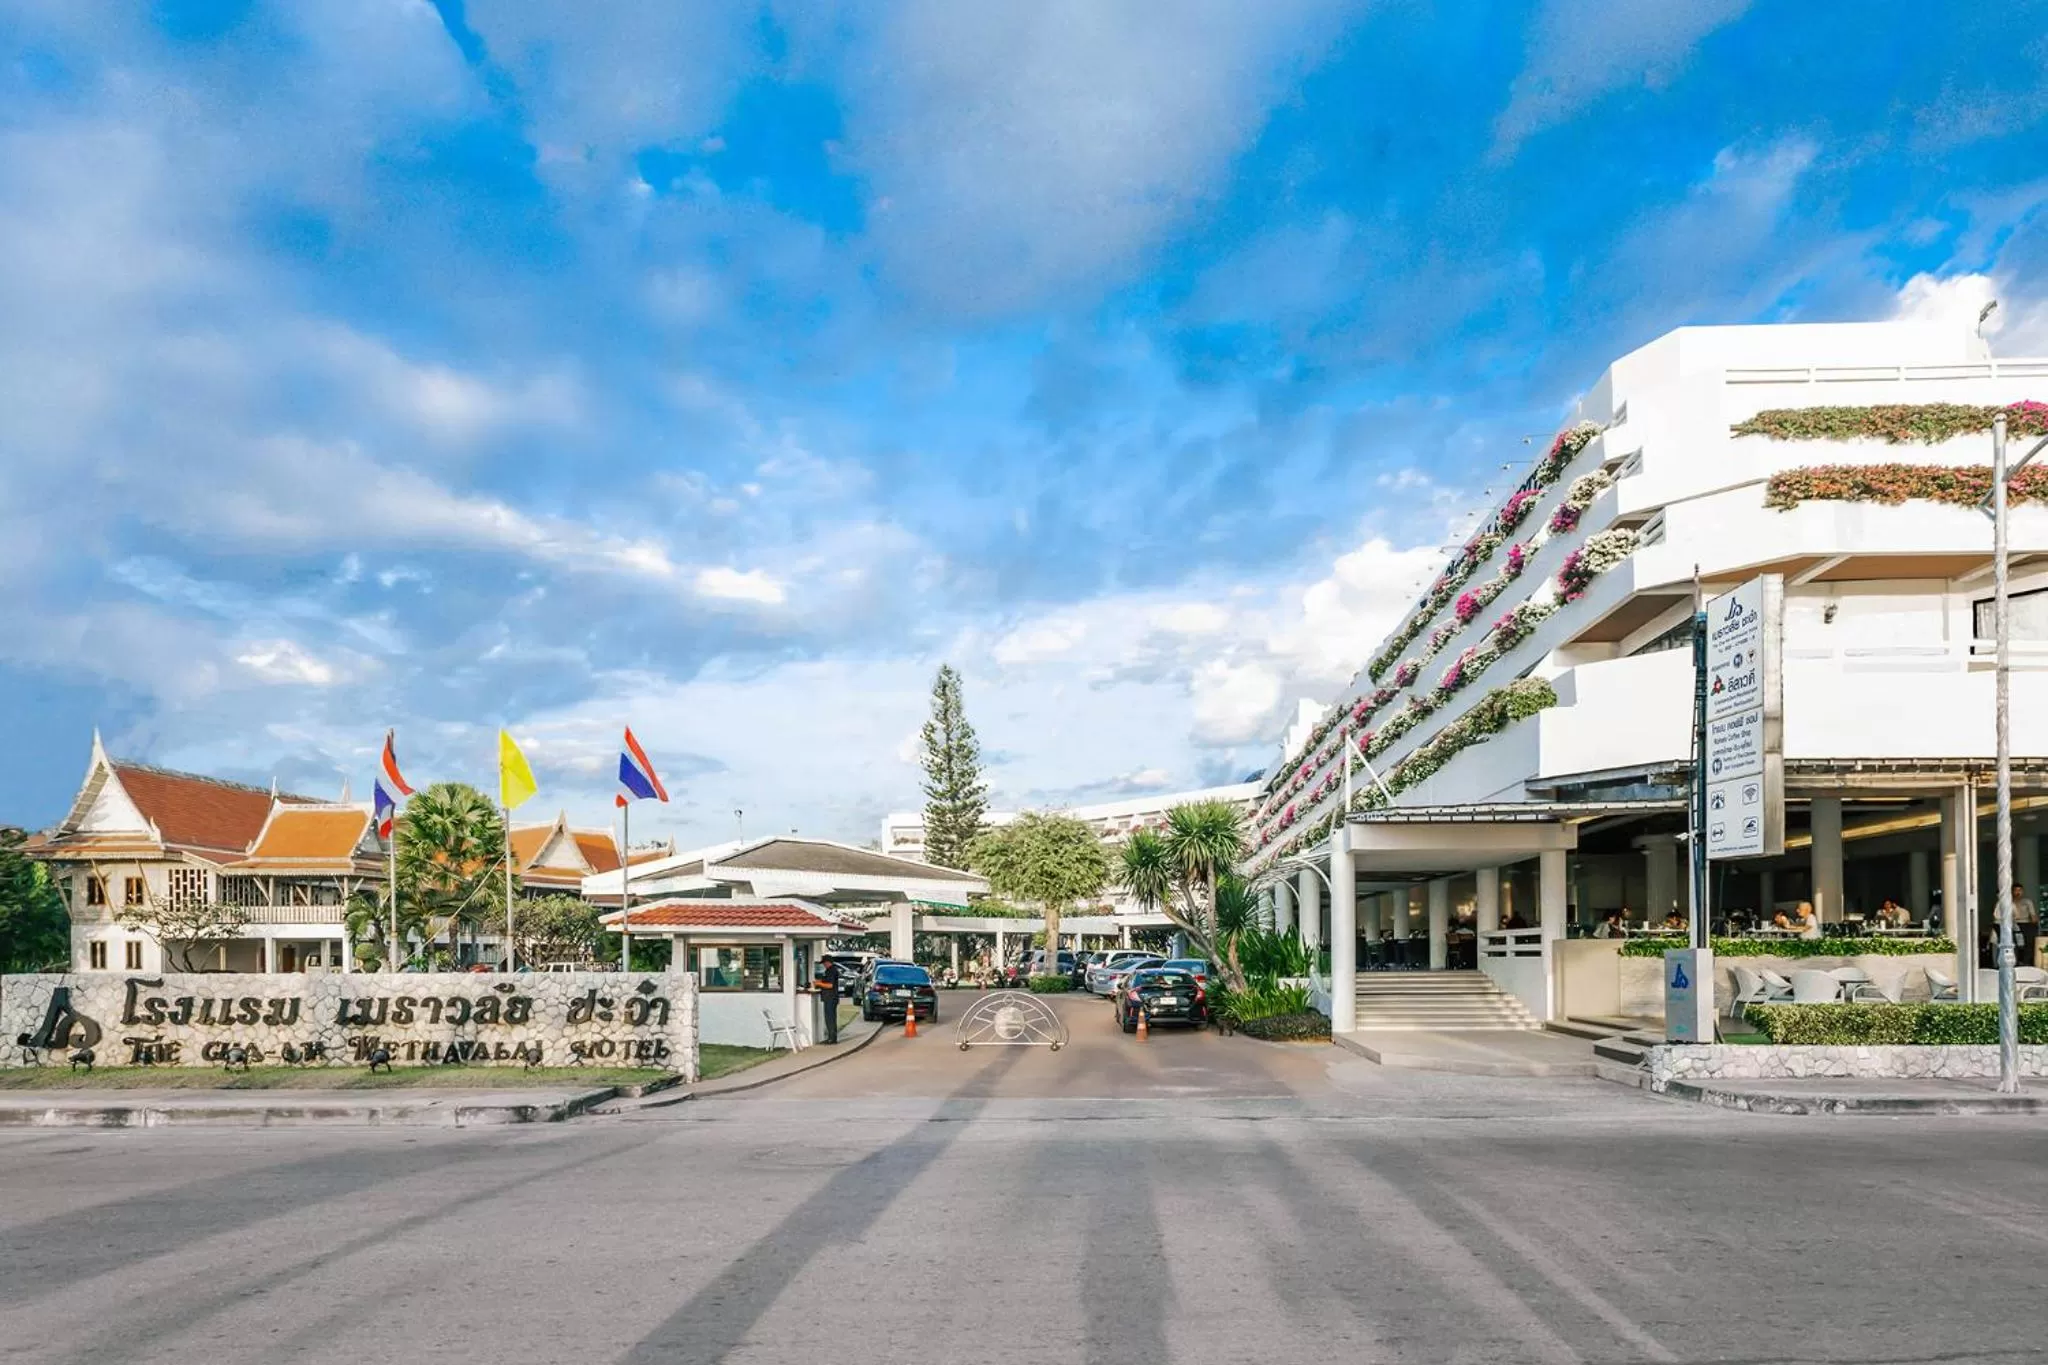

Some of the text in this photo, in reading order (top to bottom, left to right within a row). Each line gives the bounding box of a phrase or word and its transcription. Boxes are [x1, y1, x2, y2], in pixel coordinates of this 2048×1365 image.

[120, 977, 671, 1026] โรงแรม เมธาวลัย ชะอำ
[570, 1039, 671, 1060] HOTEL
